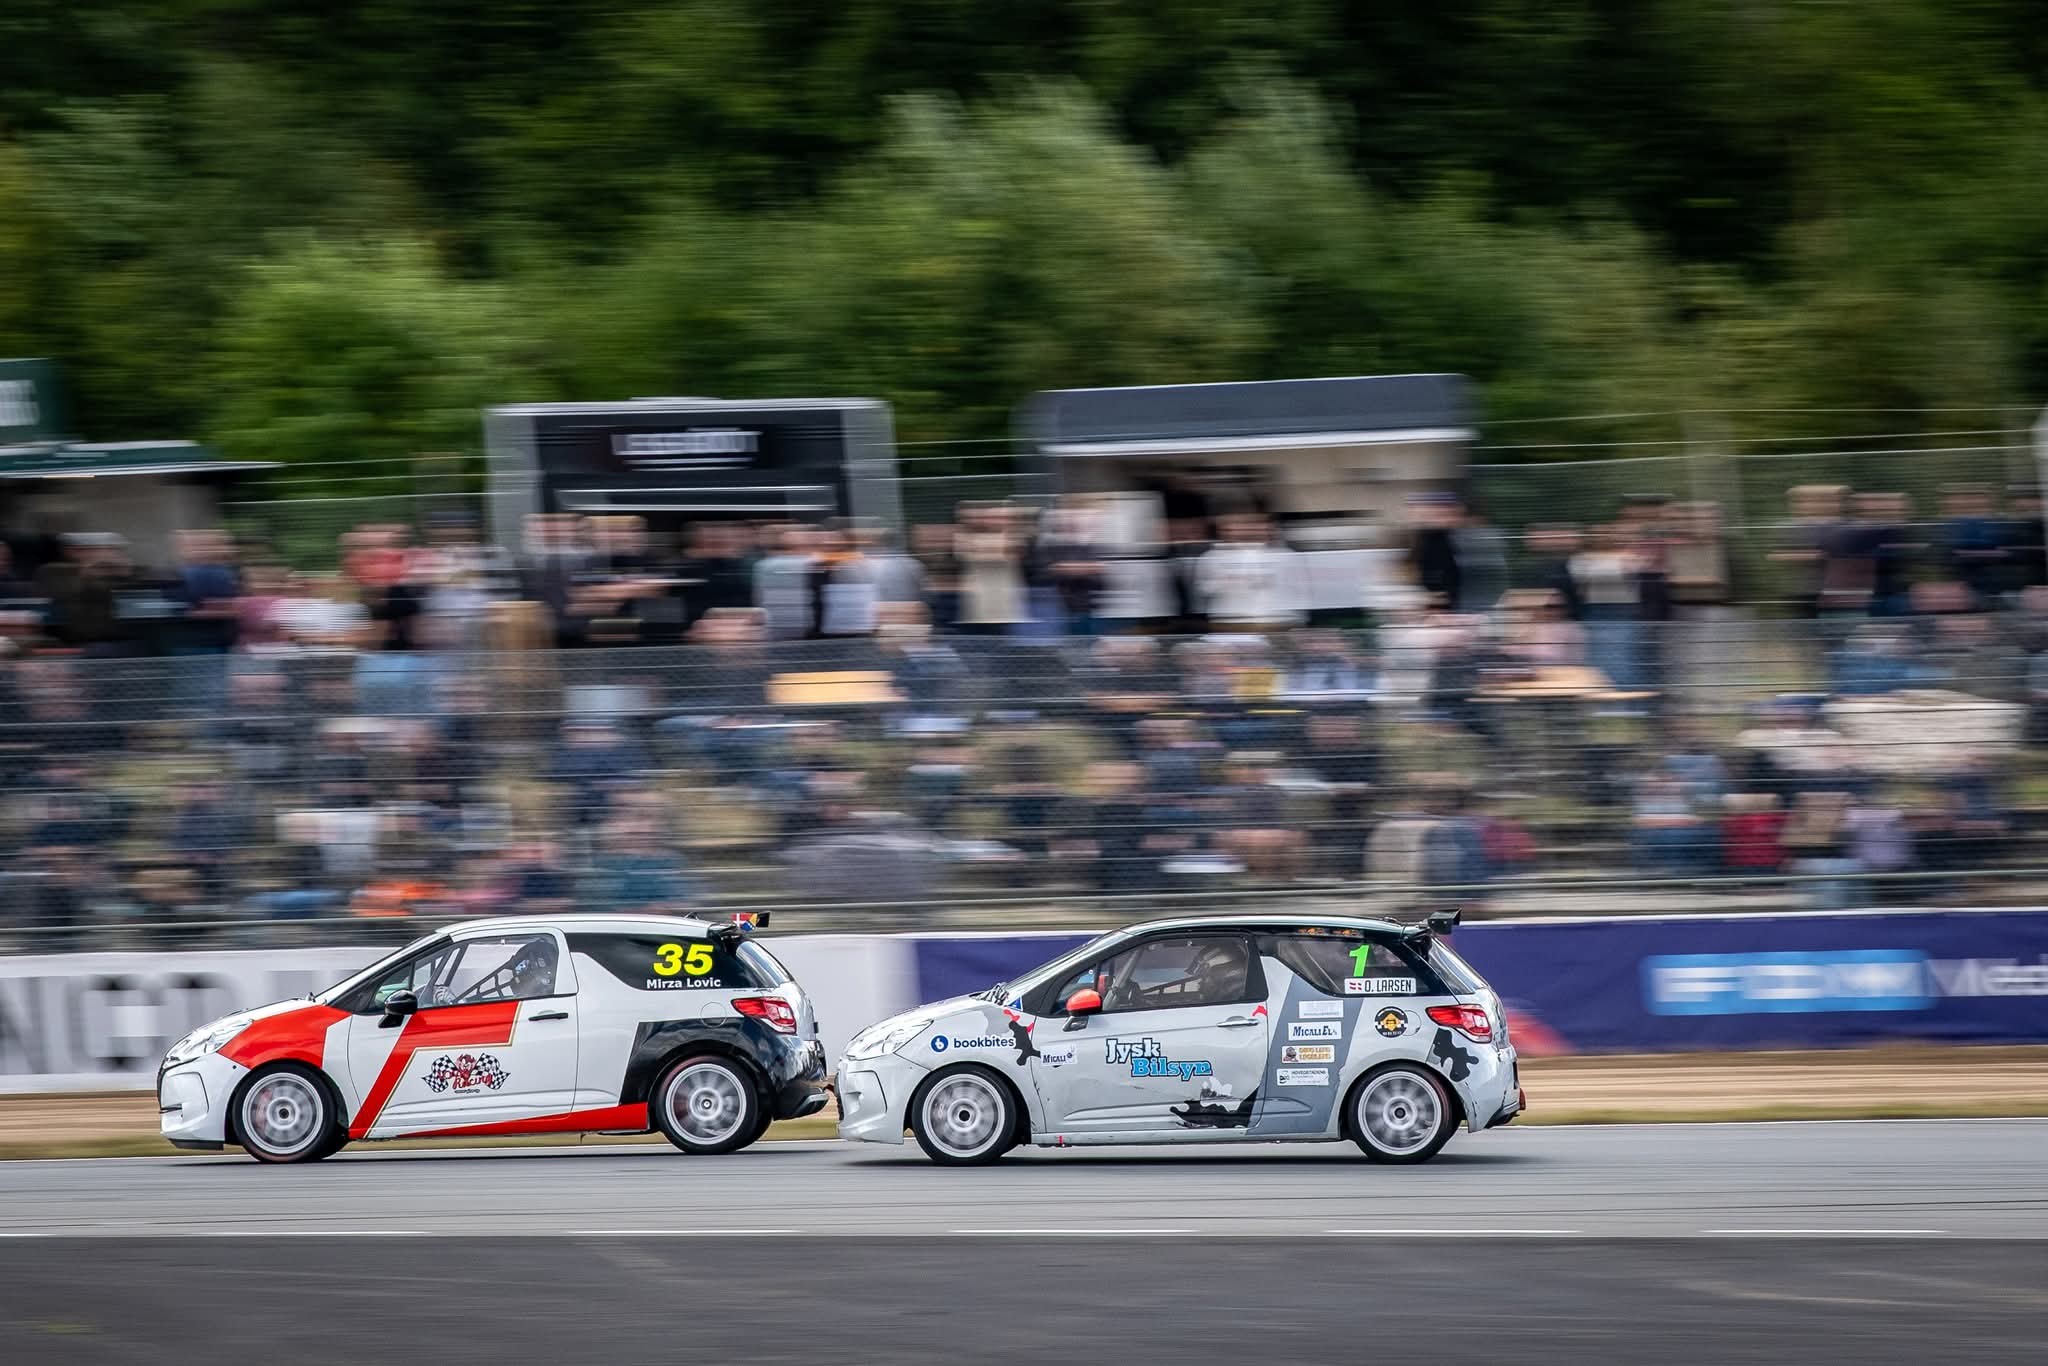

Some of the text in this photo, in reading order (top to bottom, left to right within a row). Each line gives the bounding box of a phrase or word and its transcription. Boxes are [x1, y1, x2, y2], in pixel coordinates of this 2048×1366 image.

[653, 943, 714, 976] 35
[1349, 944, 1370, 977] 1
[646, 977, 721, 989] Mirza Lovic
[1376, 979, 1412, 992] LARSEN
[953, 1036, 1015, 1049] bookbites
[1106, 1038, 1161, 1064] Jysk
[1131, 1056, 1213, 1082] Bilsyn
